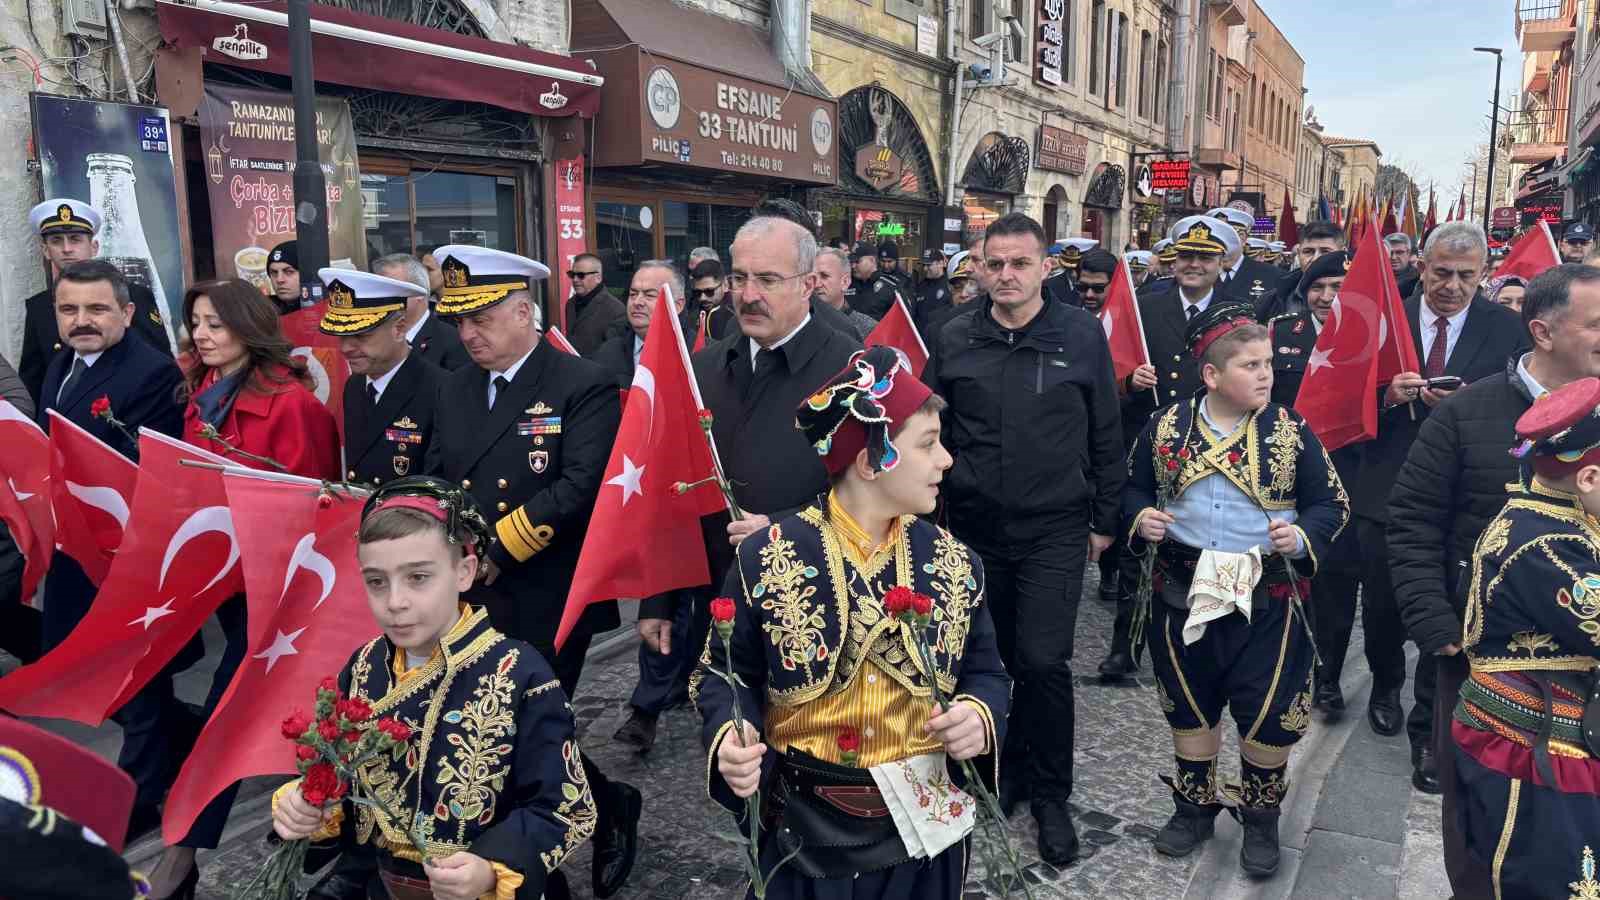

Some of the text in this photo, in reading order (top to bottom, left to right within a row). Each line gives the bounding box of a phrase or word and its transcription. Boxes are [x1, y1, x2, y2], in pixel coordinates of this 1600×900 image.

[717, 82, 782, 121] EFSANE
[699, 111, 721, 140] 33
[726, 116, 798, 153] TANTUNİ
[721, 150, 739, 167] Tel:
[231, 175, 279, 208] Çorba
[560, 218, 583, 240] 33
